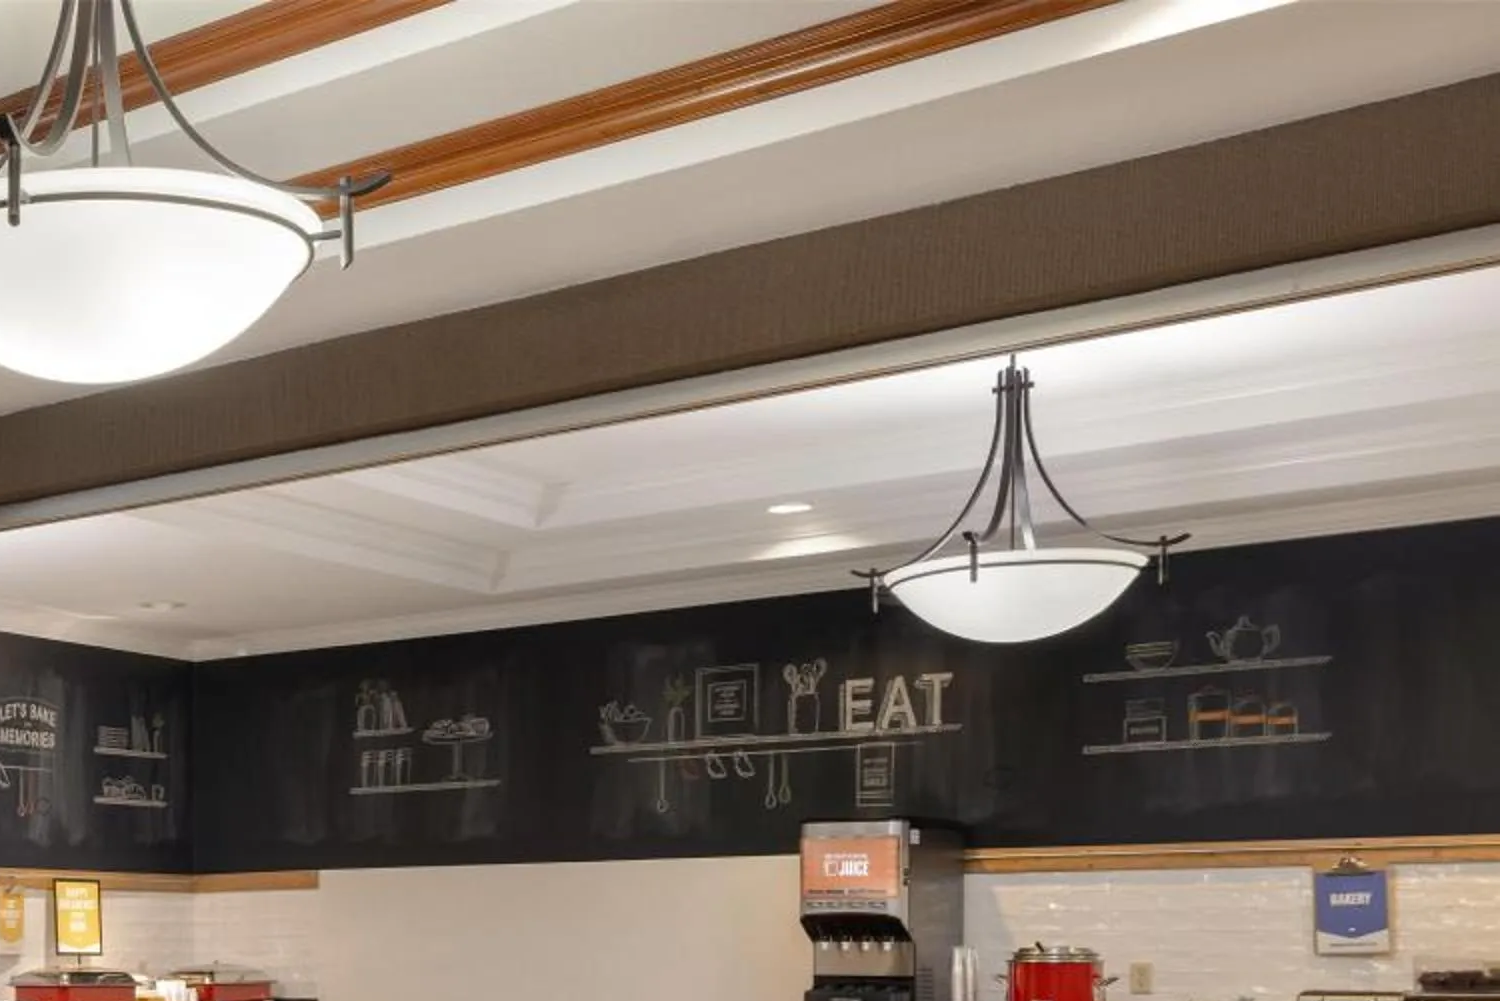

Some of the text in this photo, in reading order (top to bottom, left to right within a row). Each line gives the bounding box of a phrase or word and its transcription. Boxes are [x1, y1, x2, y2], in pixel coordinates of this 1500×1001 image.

[839, 671, 954, 732] EAT
[0, 727, 56, 749] MEMORIES
[838, 859, 870, 877] JUICE
[1329, 892, 1372, 908] BAKERY
